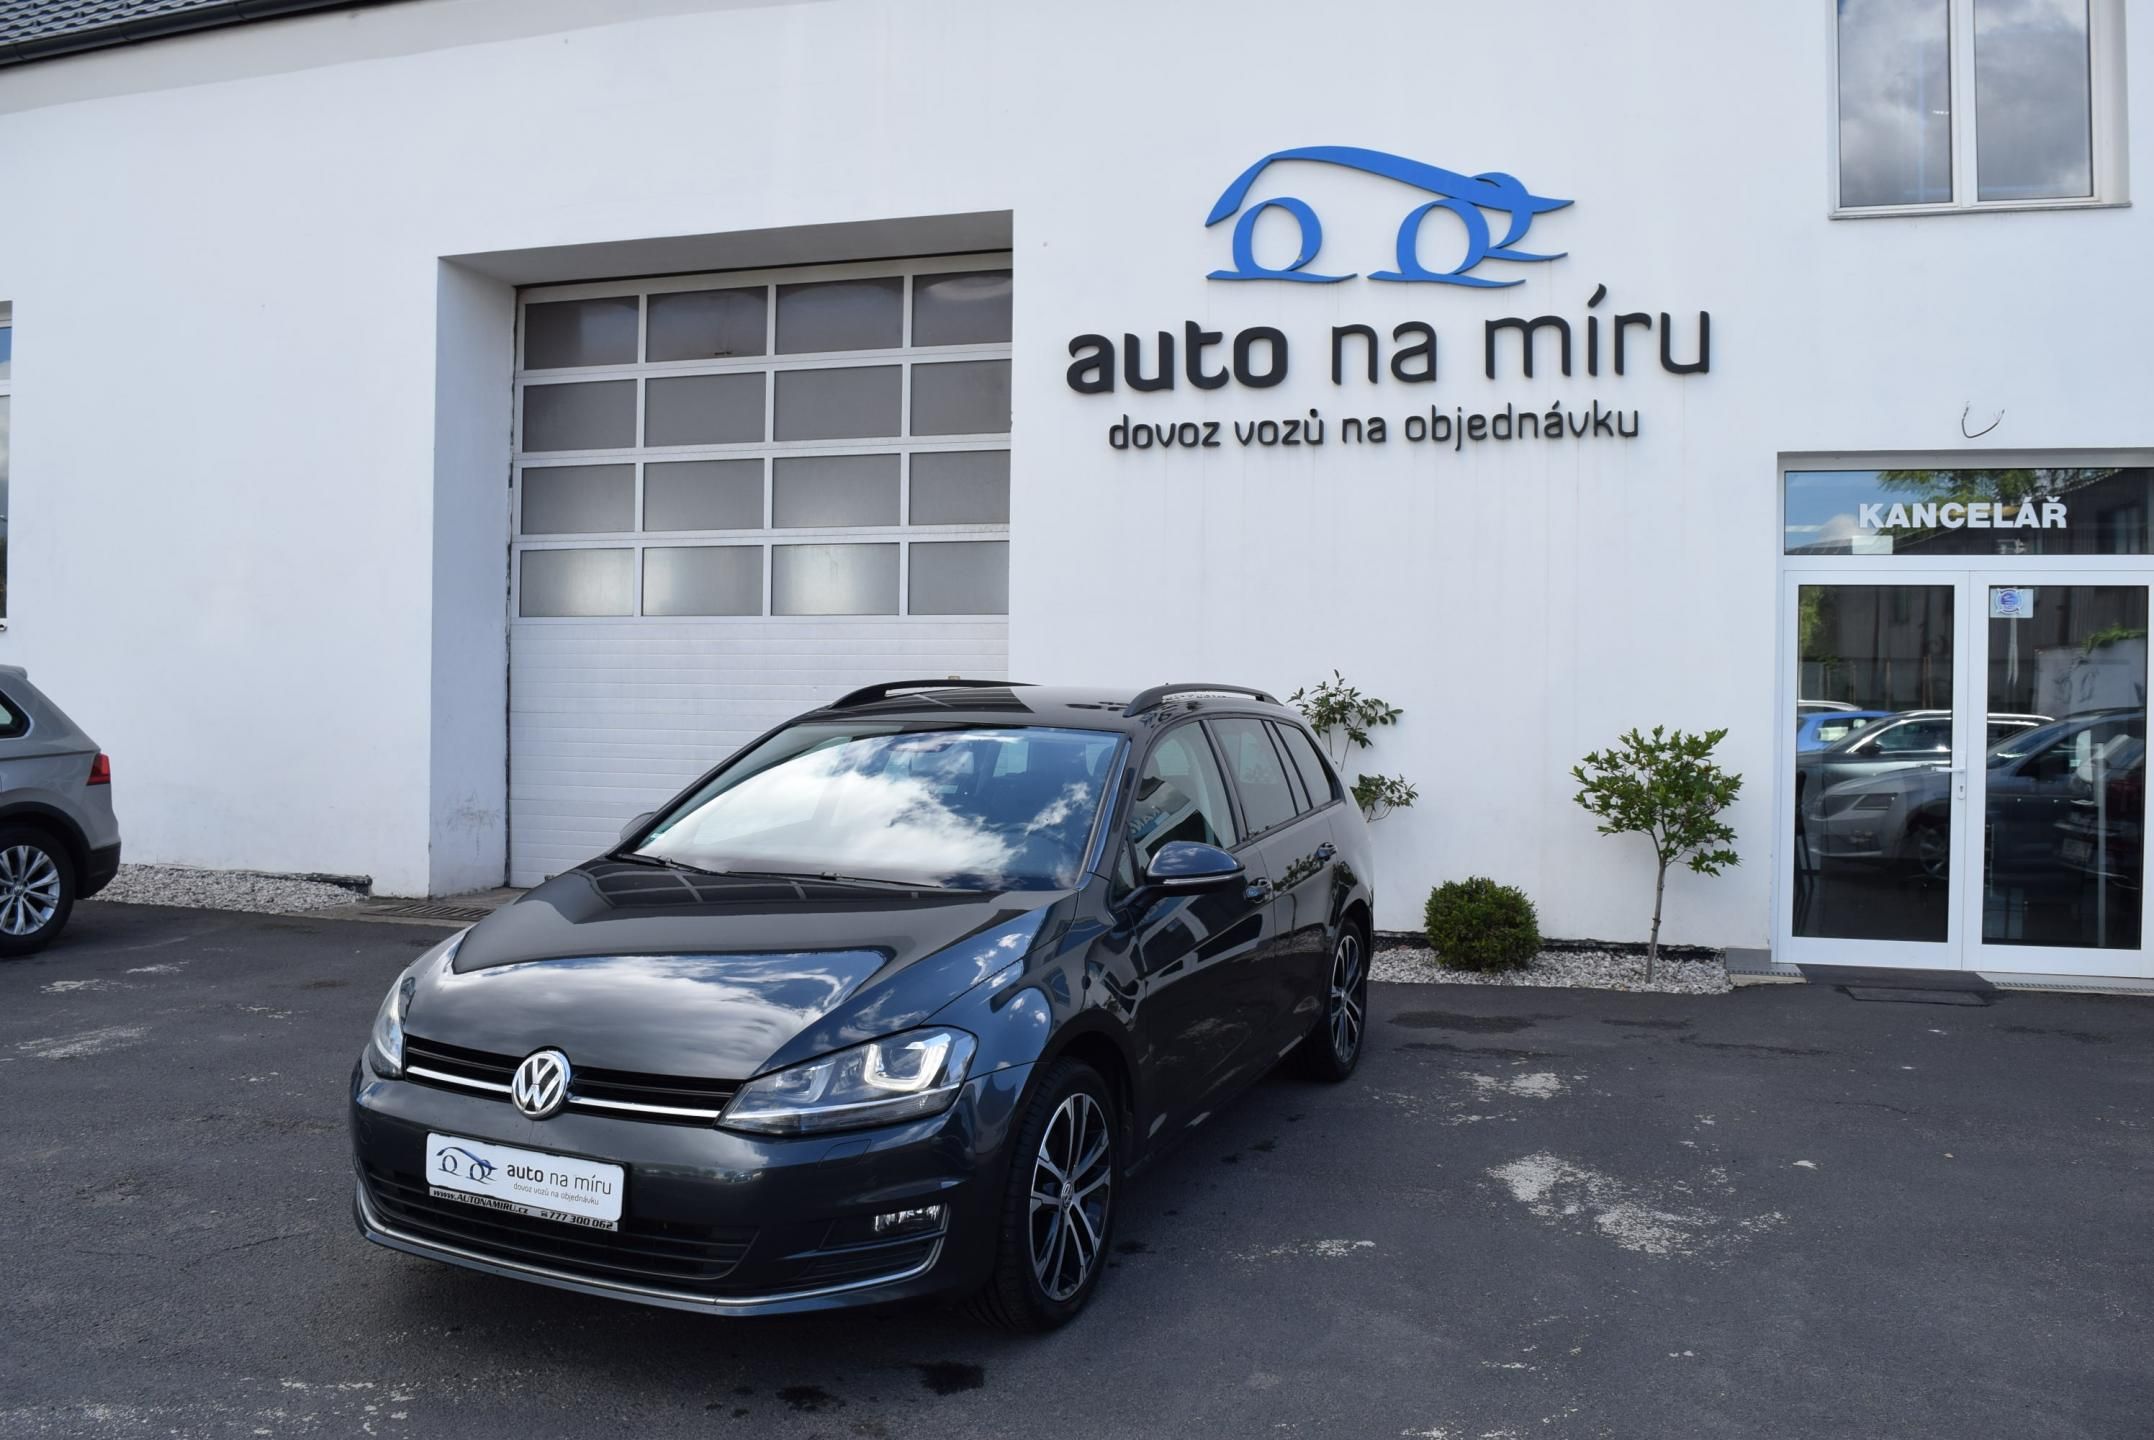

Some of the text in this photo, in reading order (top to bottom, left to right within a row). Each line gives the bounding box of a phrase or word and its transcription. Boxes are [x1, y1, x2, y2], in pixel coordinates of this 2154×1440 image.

[1066, 282, 1711, 395] auto na míru
[1108, 399, 1640, 452] dovoz vozů na objednávku
[1858, 495, 2068, 529] KANCELÁŘ
[506, 1163, 612, 1195] auto na míru
[513, 1182, 599, 1206] dovoz vozů na objednávku
[433, 1189, 528, 1215] www.AUTONAMIRU.cz
[549, 1211, 568, 1222] 777
[570, 1215, 590, 1226] 300
